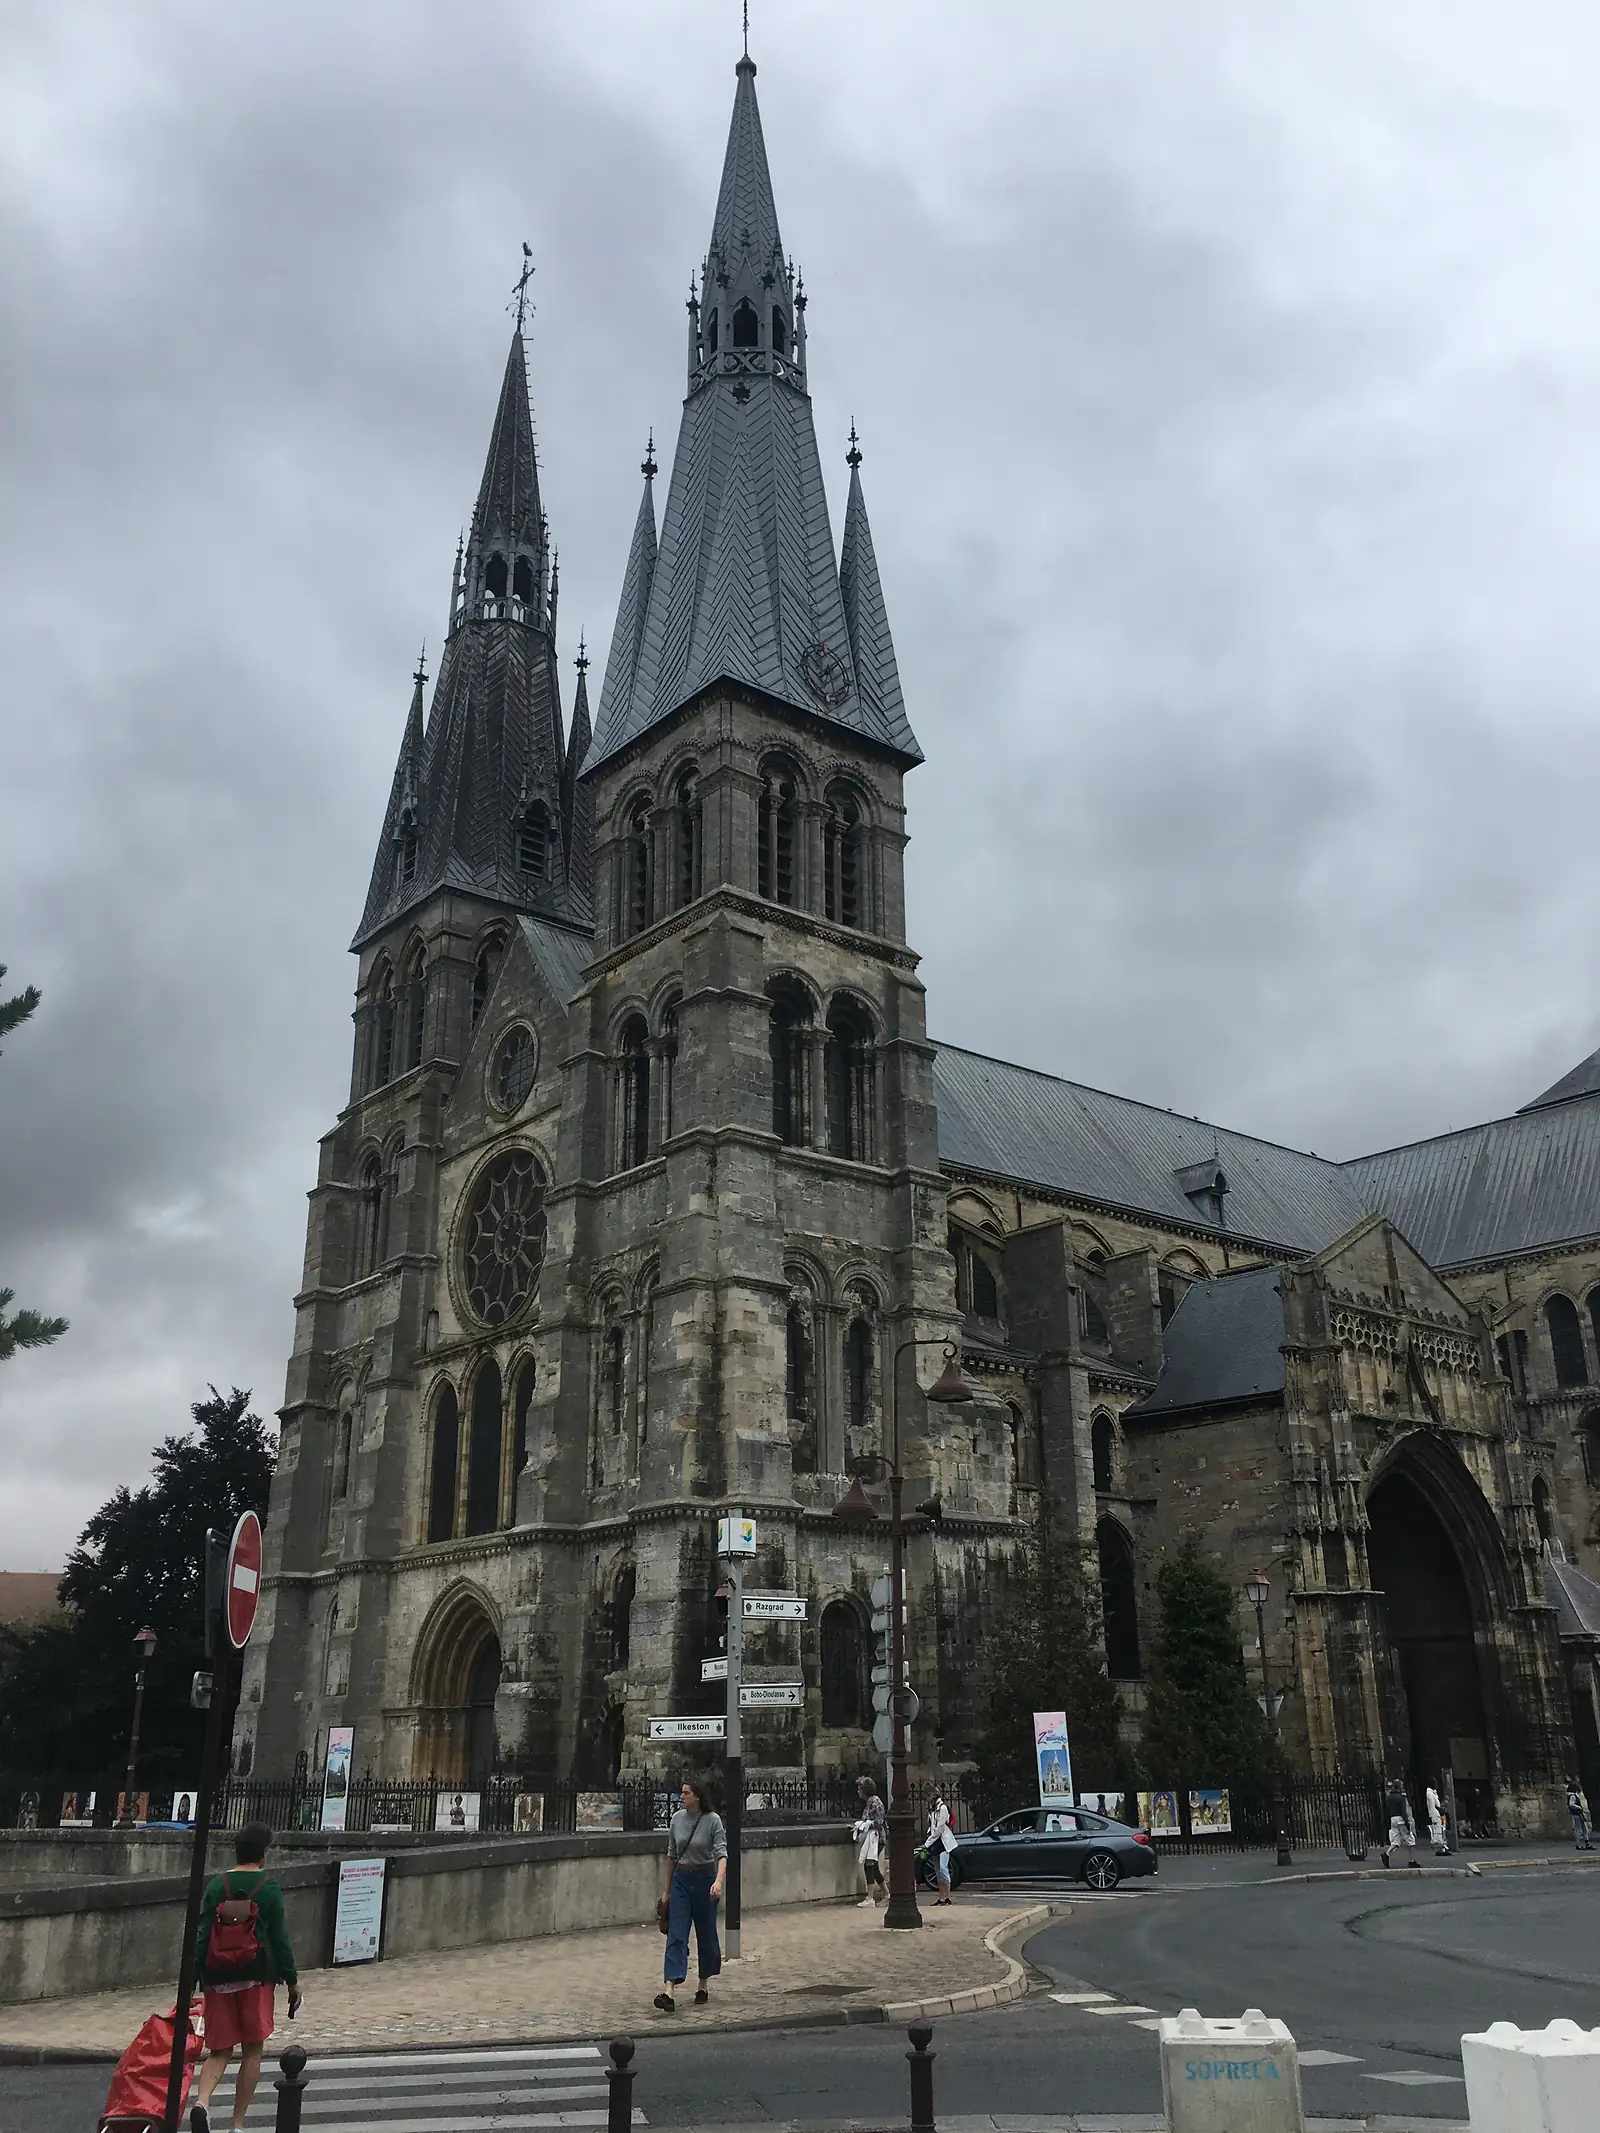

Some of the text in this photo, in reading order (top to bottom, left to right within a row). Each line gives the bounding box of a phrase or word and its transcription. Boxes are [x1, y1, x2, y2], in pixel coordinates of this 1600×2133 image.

[755, 1602, 784, 1612] Razgrad
[677, 1723, 710, 1731] Ilkeston
[1185, 2060, 1280, 2081] SOPRECA
